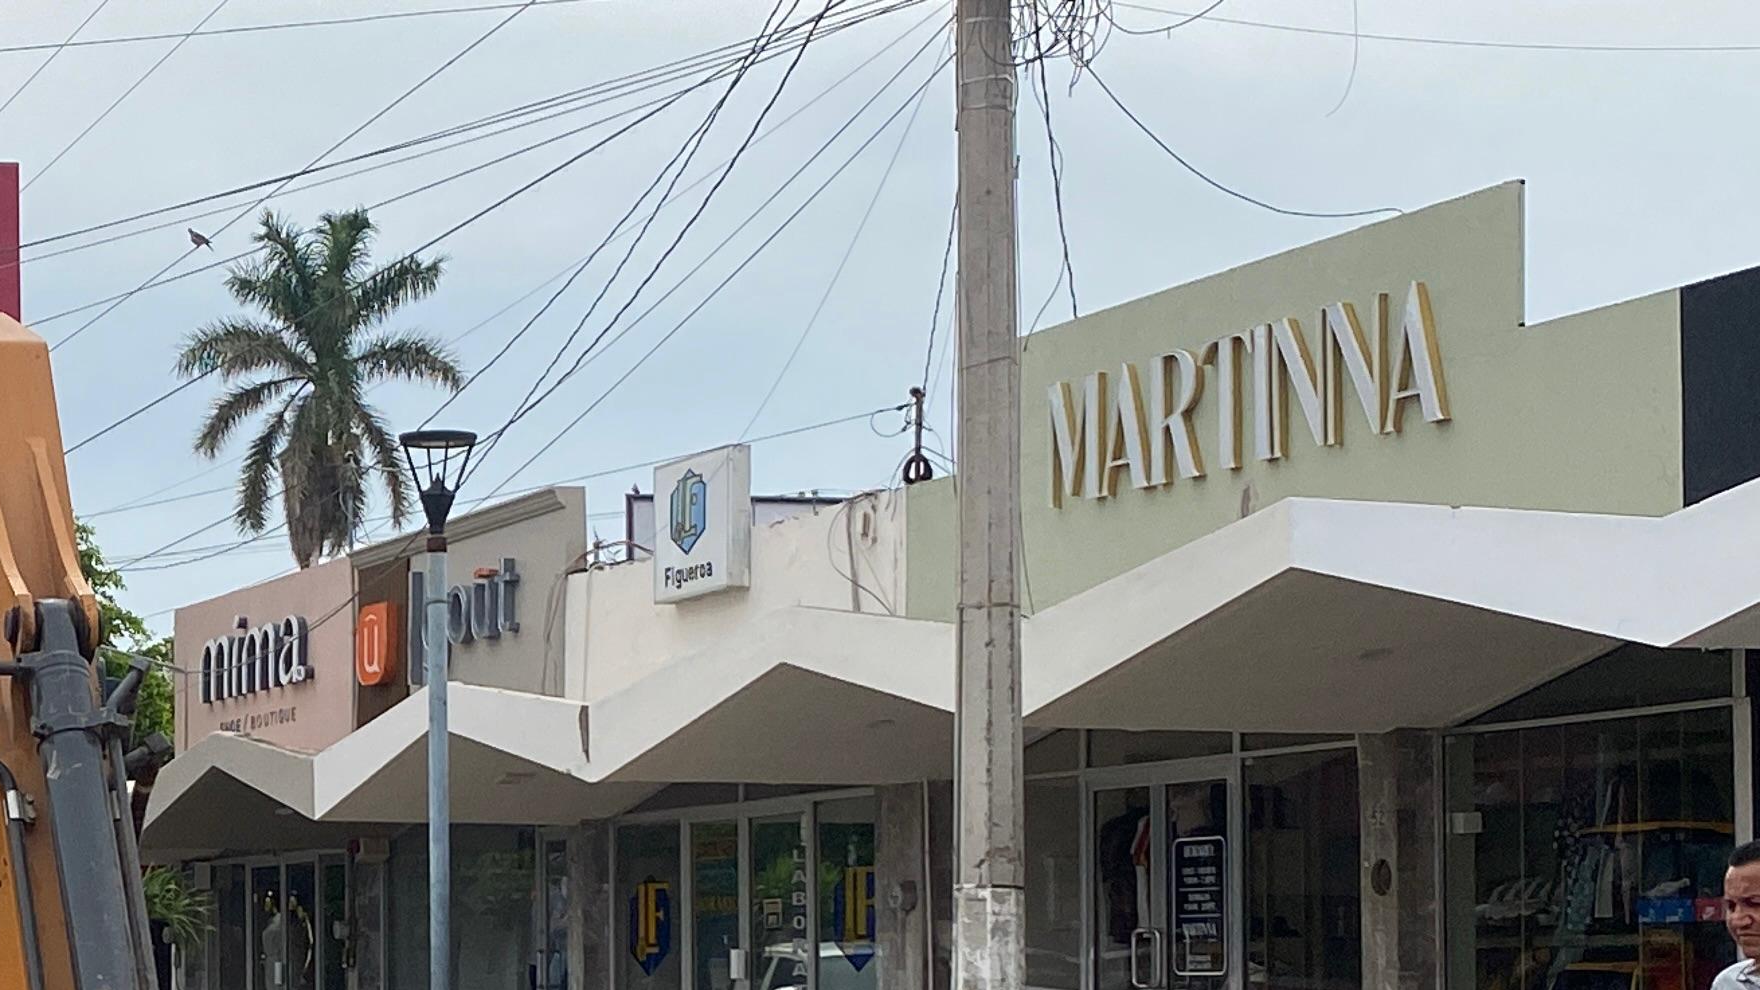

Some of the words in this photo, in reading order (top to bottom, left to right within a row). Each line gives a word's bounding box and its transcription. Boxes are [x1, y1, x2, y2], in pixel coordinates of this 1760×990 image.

[1047, 280, 1452, 509] MARTINNA
[664, 561, 713, 589] Figueroa
[250, 706, 296, 730] BOUTIQUE
